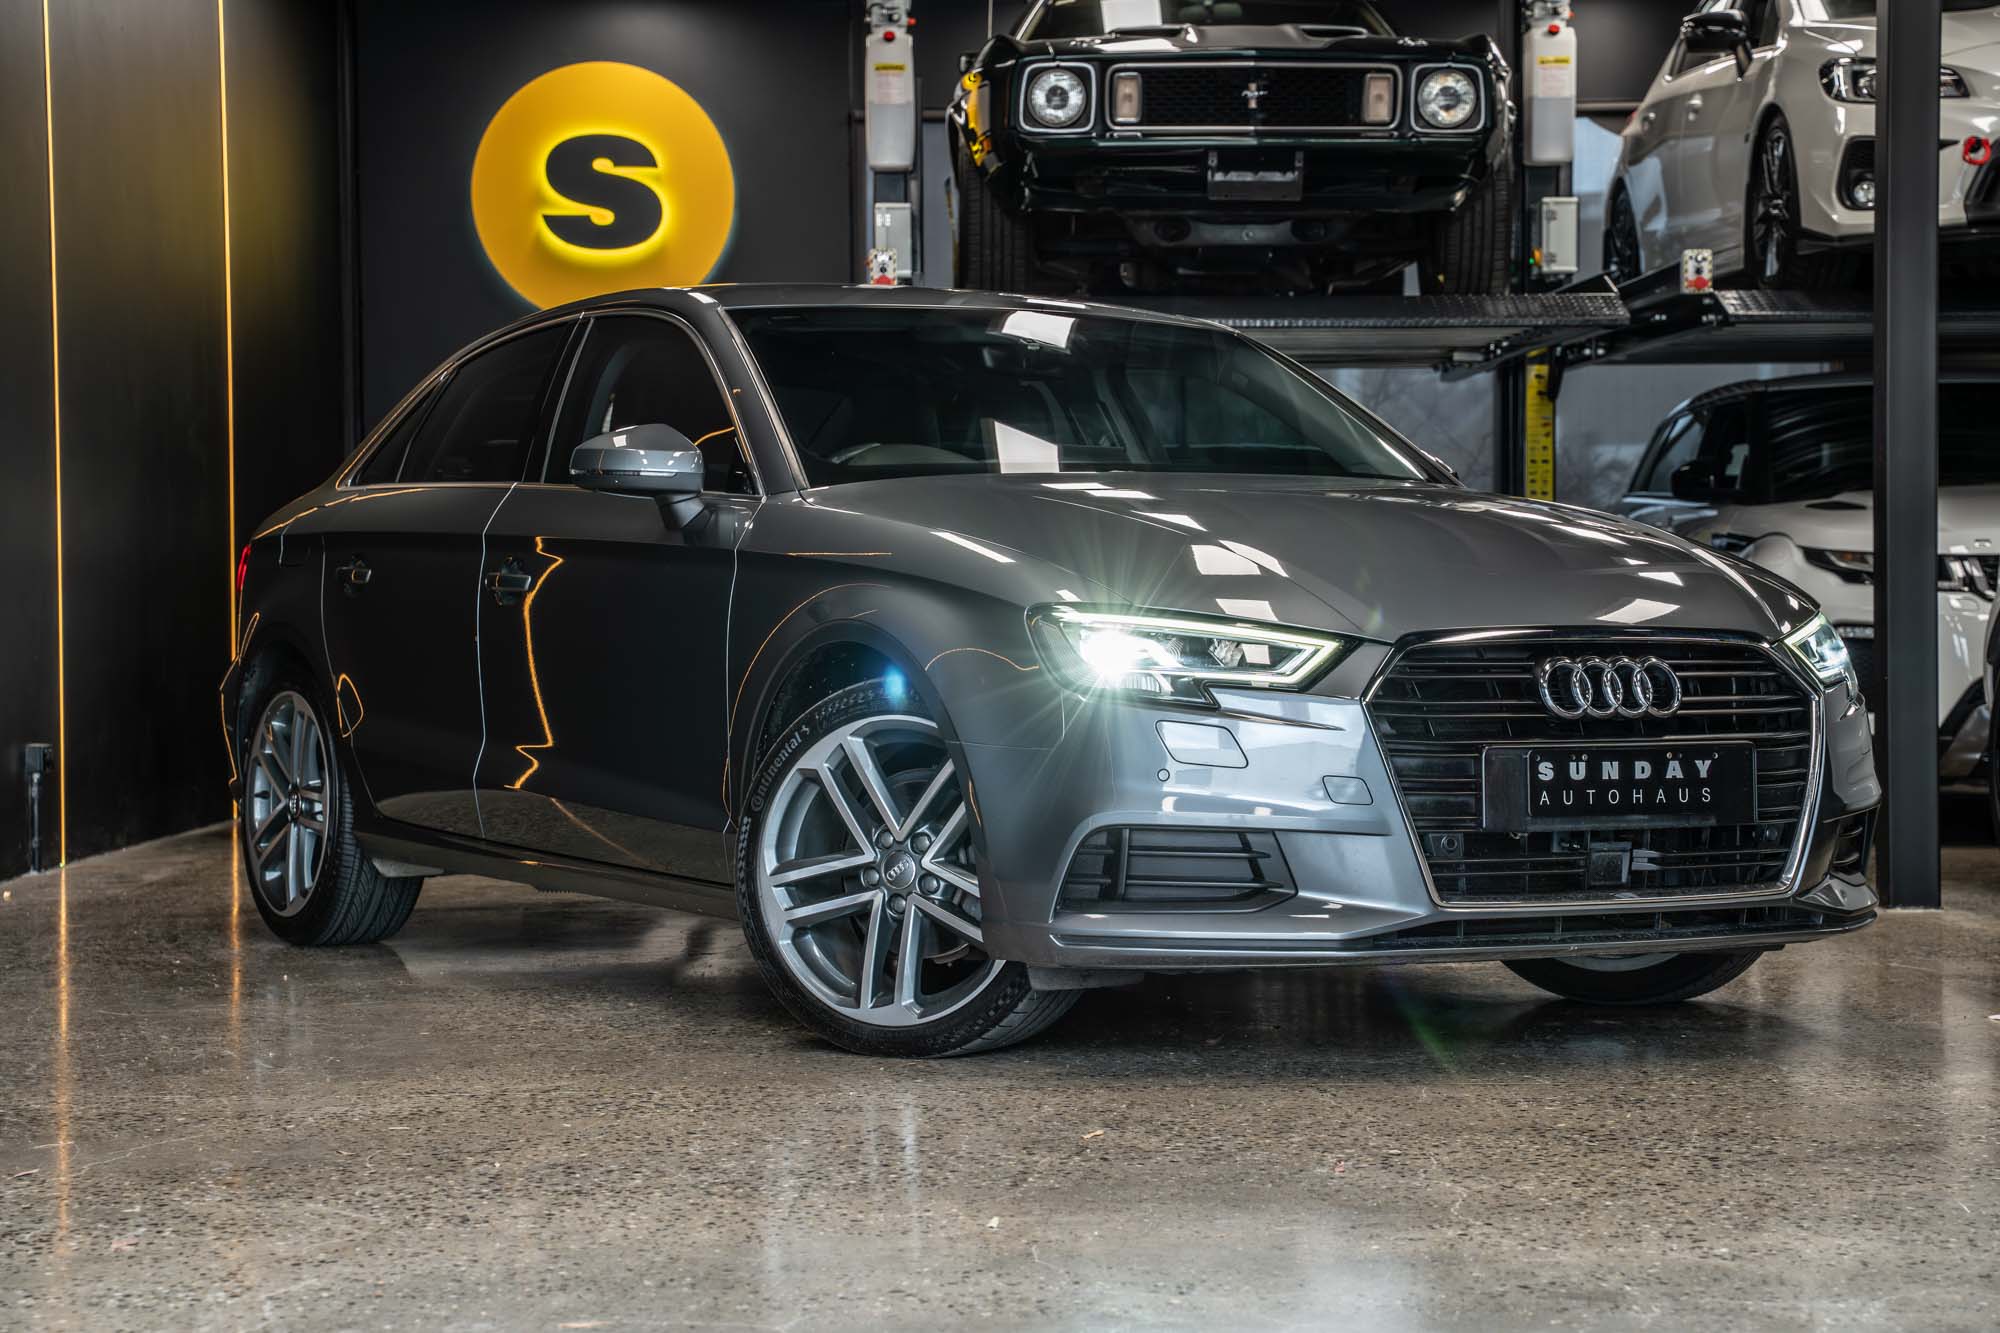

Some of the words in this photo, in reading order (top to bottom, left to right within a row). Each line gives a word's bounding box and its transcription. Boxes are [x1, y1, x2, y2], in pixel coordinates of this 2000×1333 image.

[542, 133, 663, 250] S
[751, 731, 802, 812] Continental
[1537, 759, 1713, 781] SUNDAY
[1539, 787, 1712, 806] AUTOHAUS
